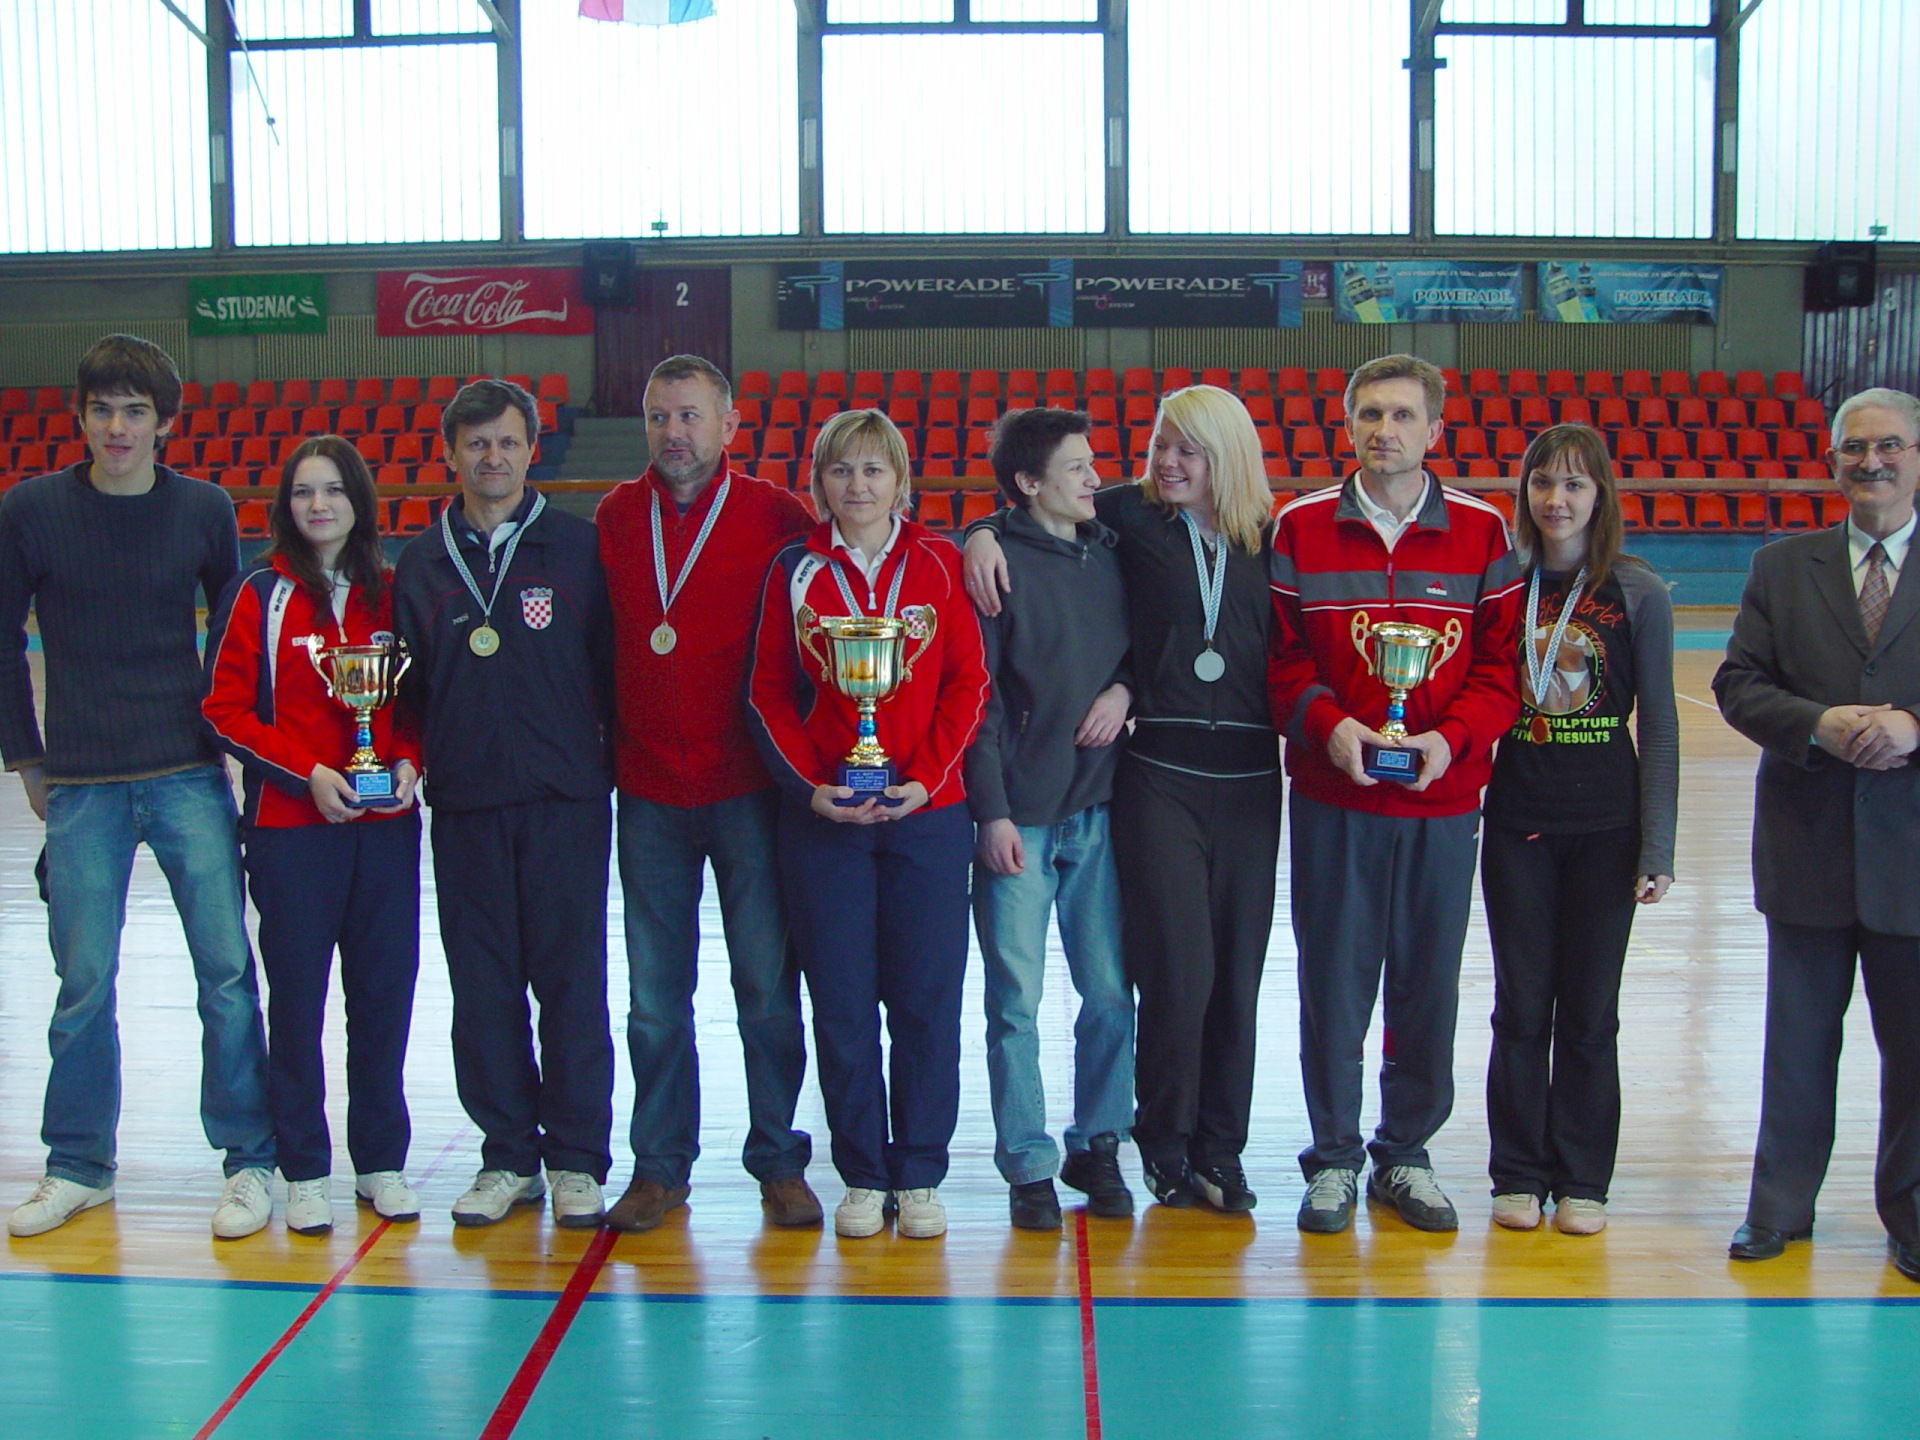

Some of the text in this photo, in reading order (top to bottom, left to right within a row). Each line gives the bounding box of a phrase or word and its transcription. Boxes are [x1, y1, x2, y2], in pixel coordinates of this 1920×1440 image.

[845, 278, 1016, 293] POWERADE
[1075, 276, 1247, 292] POWERADE
[675, 281, 690, 307] 2
[216, 294, 297, 320] STUDENAC
[1555, 730, 1611, 744] RESULTS
